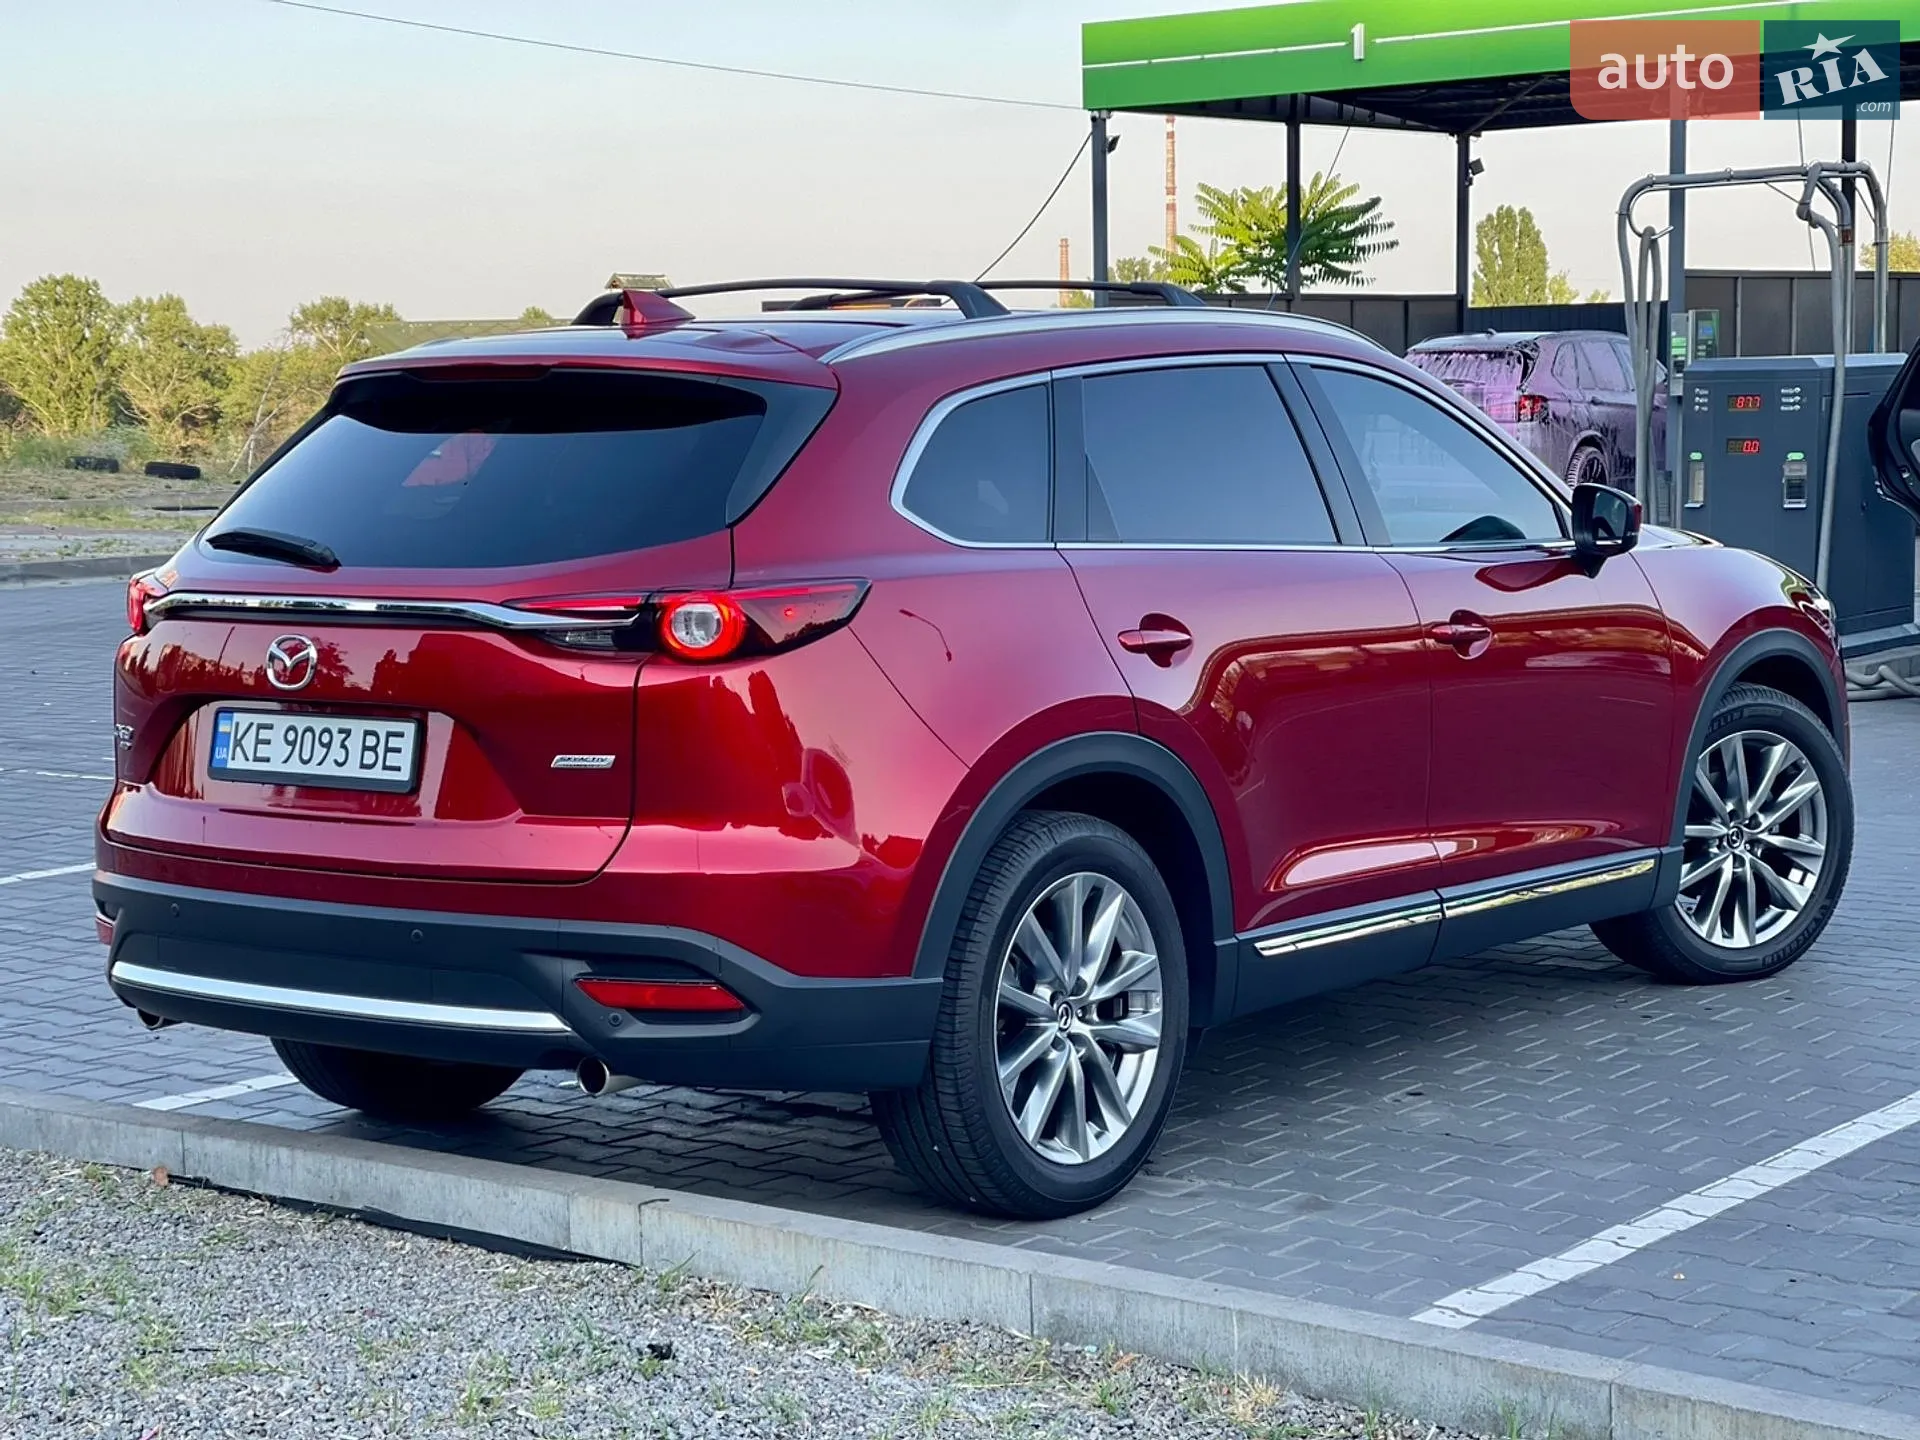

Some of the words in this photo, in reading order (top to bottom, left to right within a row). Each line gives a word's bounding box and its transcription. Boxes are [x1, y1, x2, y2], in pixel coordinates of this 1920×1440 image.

[1351, 23, 1365, 60] 1
[215, 746, 227, 760] UA
[231, 721, 274, 763] KE
[281, 724, 352, 768] 9093
[359, 729, 405, 772] BE
